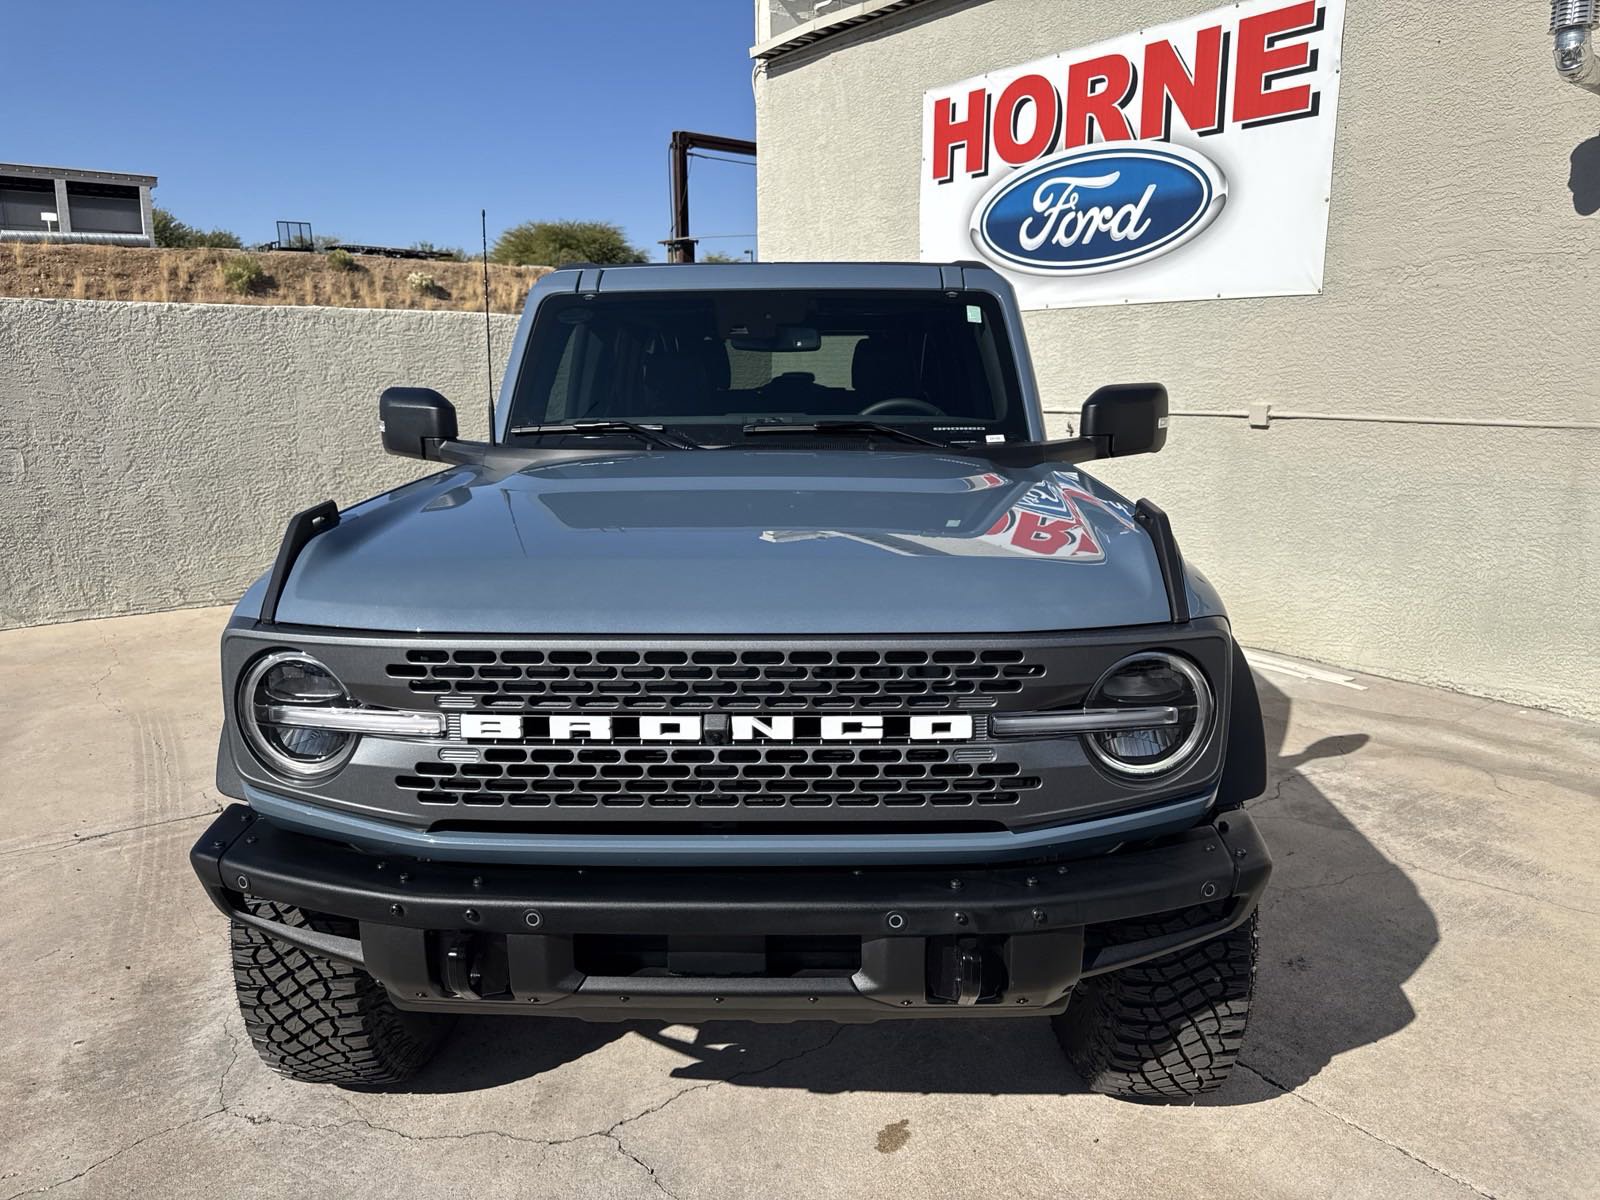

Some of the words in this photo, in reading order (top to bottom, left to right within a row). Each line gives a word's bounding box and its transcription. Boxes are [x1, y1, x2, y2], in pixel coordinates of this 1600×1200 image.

[933, 0, 1324, 183] HORNE
[1019, 170, 1157, 251] Ford
[460, 713, 973, 740] BRONCO
